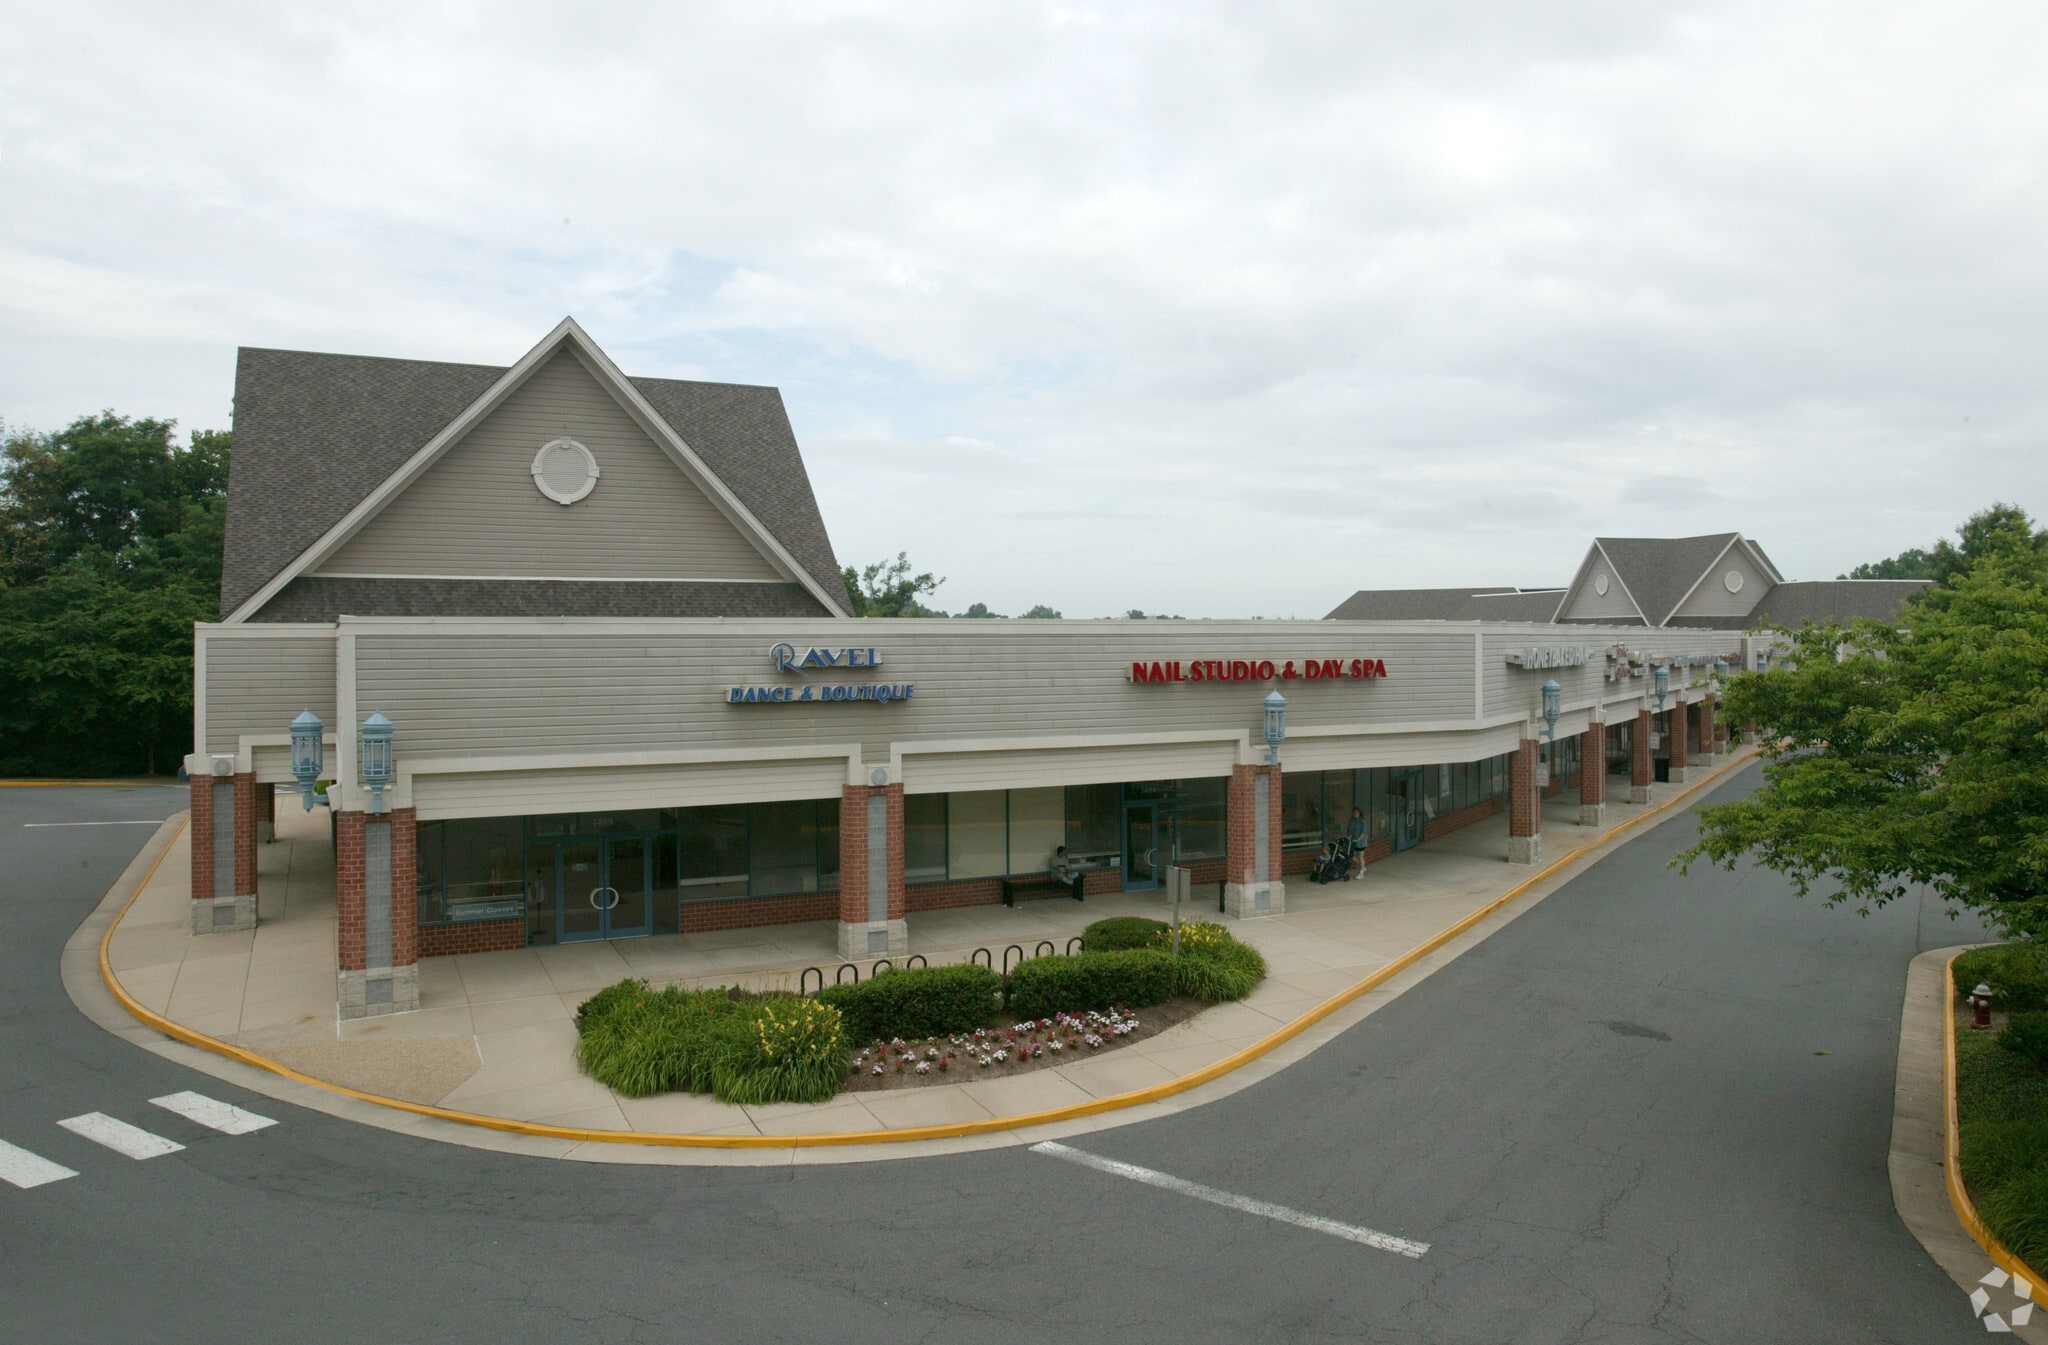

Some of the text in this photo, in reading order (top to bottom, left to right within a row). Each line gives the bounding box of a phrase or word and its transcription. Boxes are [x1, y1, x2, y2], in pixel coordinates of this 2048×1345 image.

[769, 642, 884, 676] RAVEL
[1131, 658, 1388, 683] NAIL STUDIO & DAY SPA
[729, 684, 914, 704] DANCE & BOUTIQUE
[455, 906, 514, 917] Summer Classes
